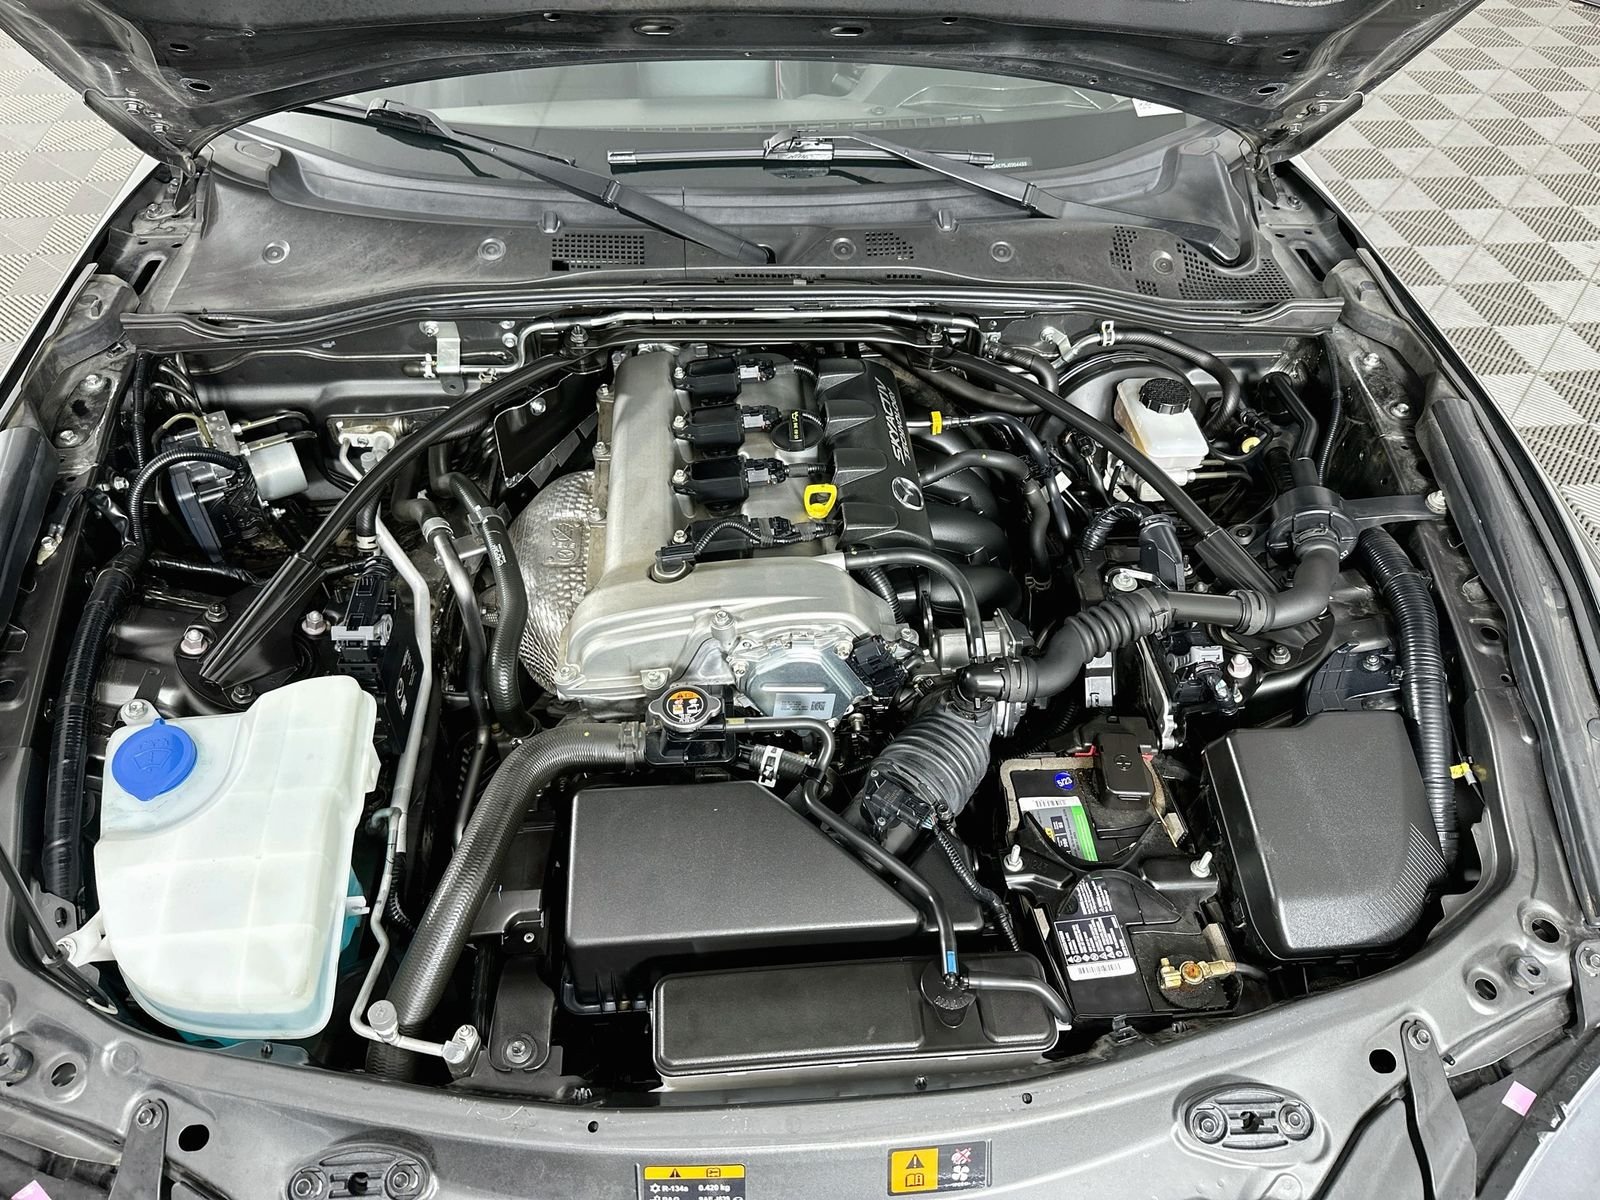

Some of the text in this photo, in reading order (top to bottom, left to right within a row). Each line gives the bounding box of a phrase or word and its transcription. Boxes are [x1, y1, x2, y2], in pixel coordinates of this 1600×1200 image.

[874, 376, 906, 467] SKYACTIV
[887, 386, 911, 462] TECHNOLOGY
[1056, 776, 1073, 787] 5/23
[720, 1184, 730, 1193] kg
